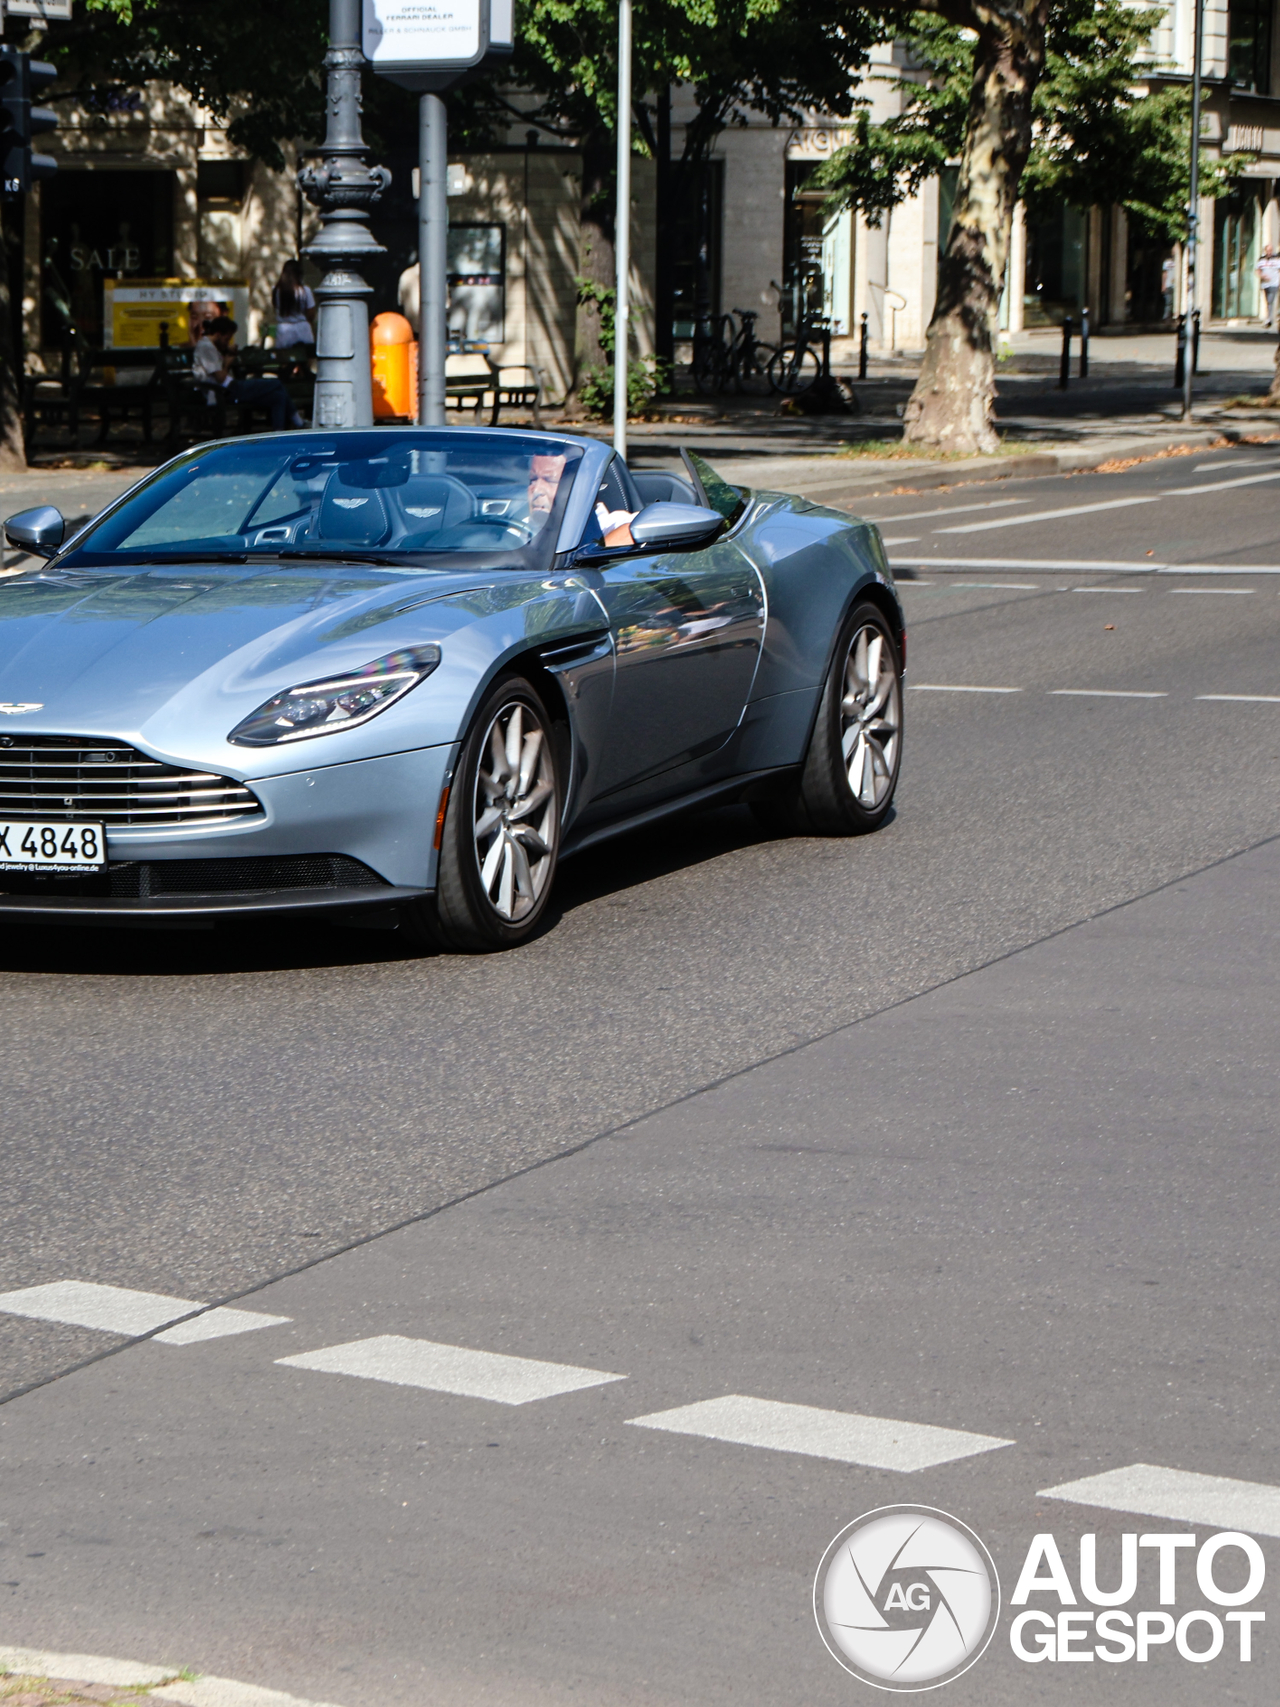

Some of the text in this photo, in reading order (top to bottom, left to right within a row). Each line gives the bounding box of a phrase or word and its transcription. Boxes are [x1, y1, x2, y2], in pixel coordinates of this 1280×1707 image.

[70, 247, 141, 271] SALE
[20, 827, 98, 859] 4848
[5, 863, 27, 871] jewelry
